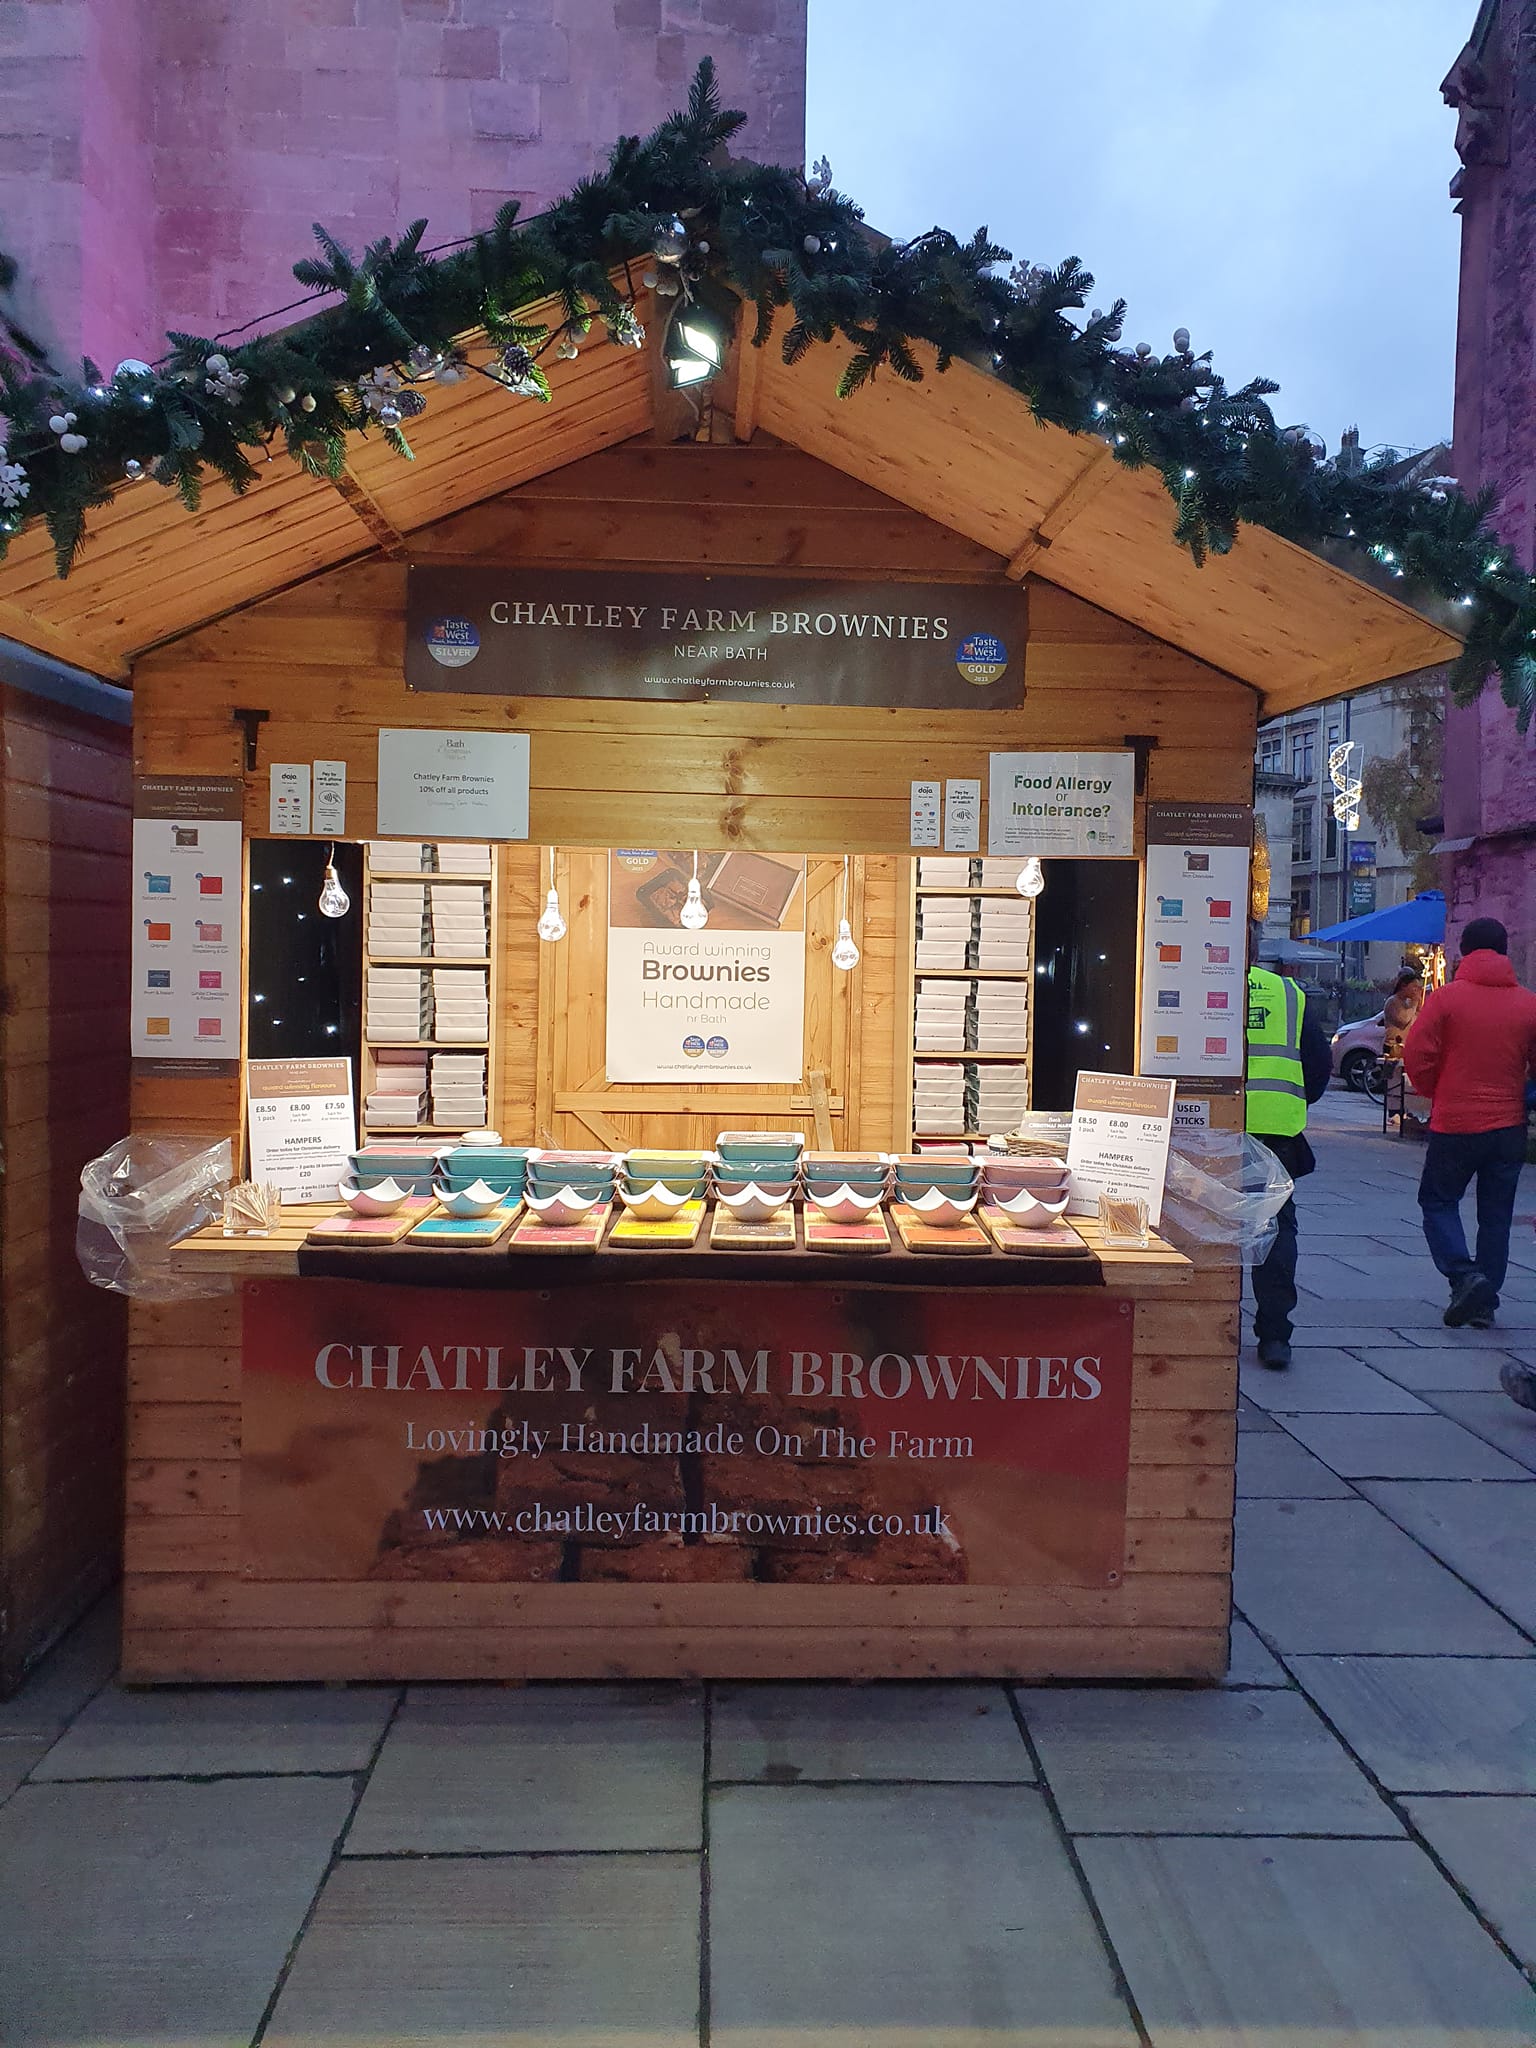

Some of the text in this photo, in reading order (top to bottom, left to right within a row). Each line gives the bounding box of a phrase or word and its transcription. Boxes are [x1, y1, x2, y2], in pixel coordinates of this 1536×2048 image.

[446, 619, 470, 629] Taste
[490, 601, 949, 640] CHATLEY FARM BROWNIES
[445, 629, 470, 640] West
[972, 636, 998, 647] Taste
[435, 647, 471, 657] SILVER
[674, 644, 767, 661] NEAR BATH
[973, 647, 997, 657] West
[967, 664, 996, 674] GOLD
[644, 675, 796, 689] www.chatleyfarmbrownies.co.uk
[446, 738, 465, 748] Bath
[281, 771, 297, 780] dojo
[413, 772, 495, 783] Chatley Farm Brownies
[142, 784, 174, 792] CHATLEY
[419, 785, 434, 793] 10%
[1014, 775, 1113, 794] Food Allergy
[1055, 792, 1069, 802] or
[1012, 802, 1111, 818] Intolerance?
[626, 857, 650, 865] GOLD
[643, 941, 772, 961] Award winning
[642, 959, 771, 982] Brownies
[643, 991, 771, 1010] Handmade
[687, 1014, 727, 1024] nr Bath
[1081, 1077, 1111, 1085] CHATLEY
[1112, 1079, 1131, 1087] FARM
[1132, 1081, 1168, 1090] BROWNIES
[255, 1102, 345, 1113] £8.50 £8.00 £7.50
[1177, 1104, 1201, 1113] USED
[1078, 1116, 1162, 1132] £8.50 £8.00 £7.50
[1174, 1116, 1205, 1126] STICKS
[284, 1135, 322, 1145] HAMPERS
[1098, 1152, 1134, 1162] HAMPERS
[314, 1342, 1102, 1401] CHATLEY FARM BROWNIES
[405, 1420, 974, 1459] Lovingly Handmade On The Farm
[422, 1502, 952, 1540] www.chatleyfarmbrownies.co.uk
